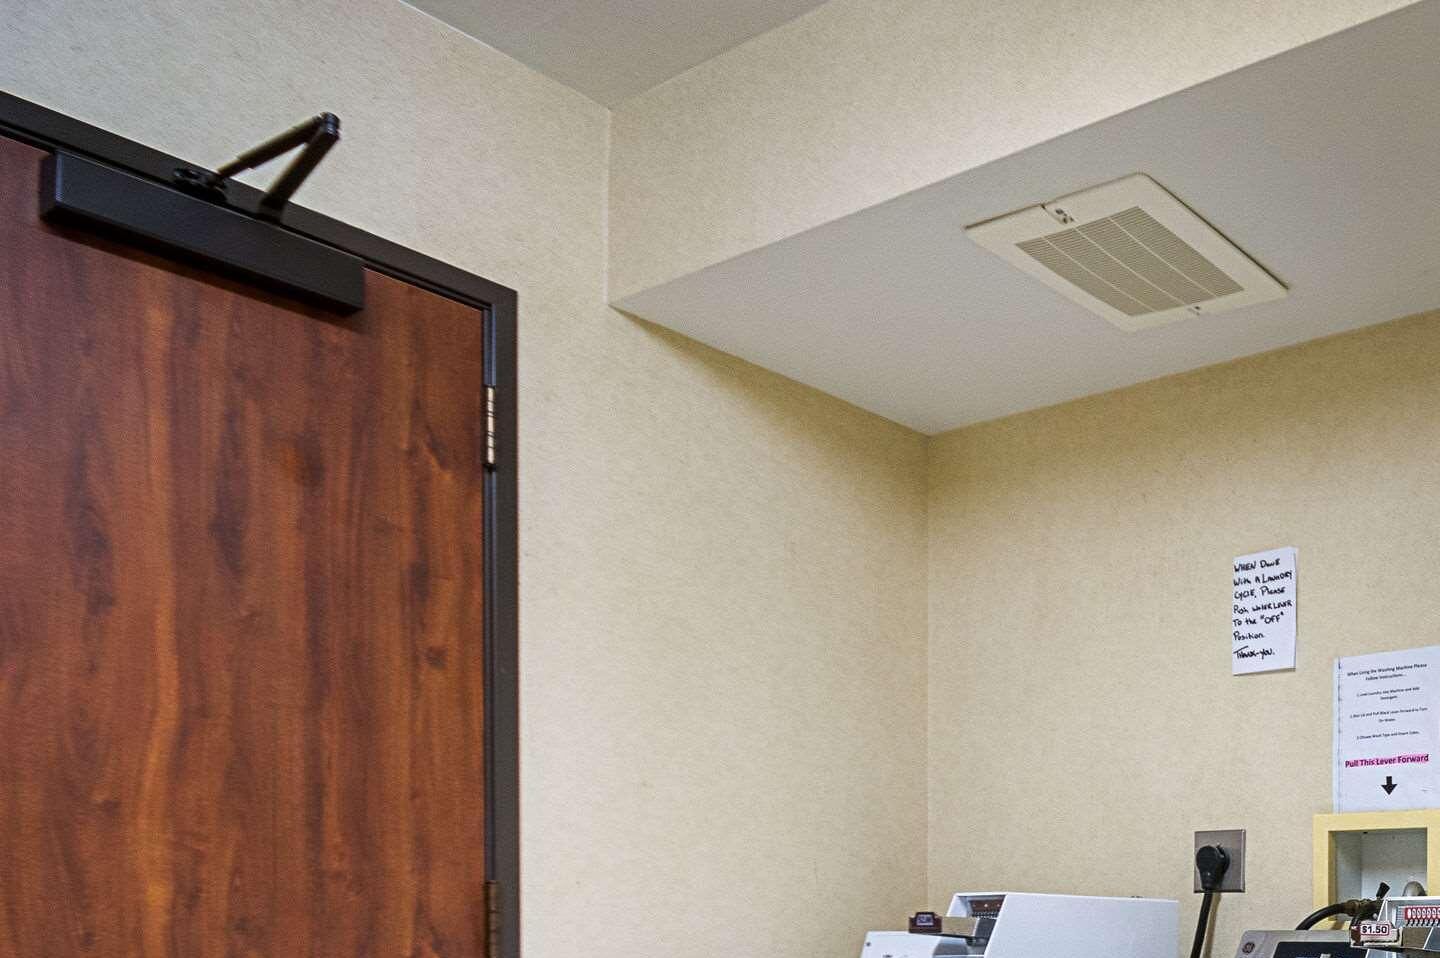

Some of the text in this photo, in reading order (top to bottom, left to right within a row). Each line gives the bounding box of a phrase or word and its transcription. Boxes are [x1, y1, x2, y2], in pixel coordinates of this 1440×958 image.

[1234, 560, 1256, 572] WHEN
[1345, 754, 1429, 768] Pull This Lever Forward
[1361, 925, 1388, 935] $1.50
